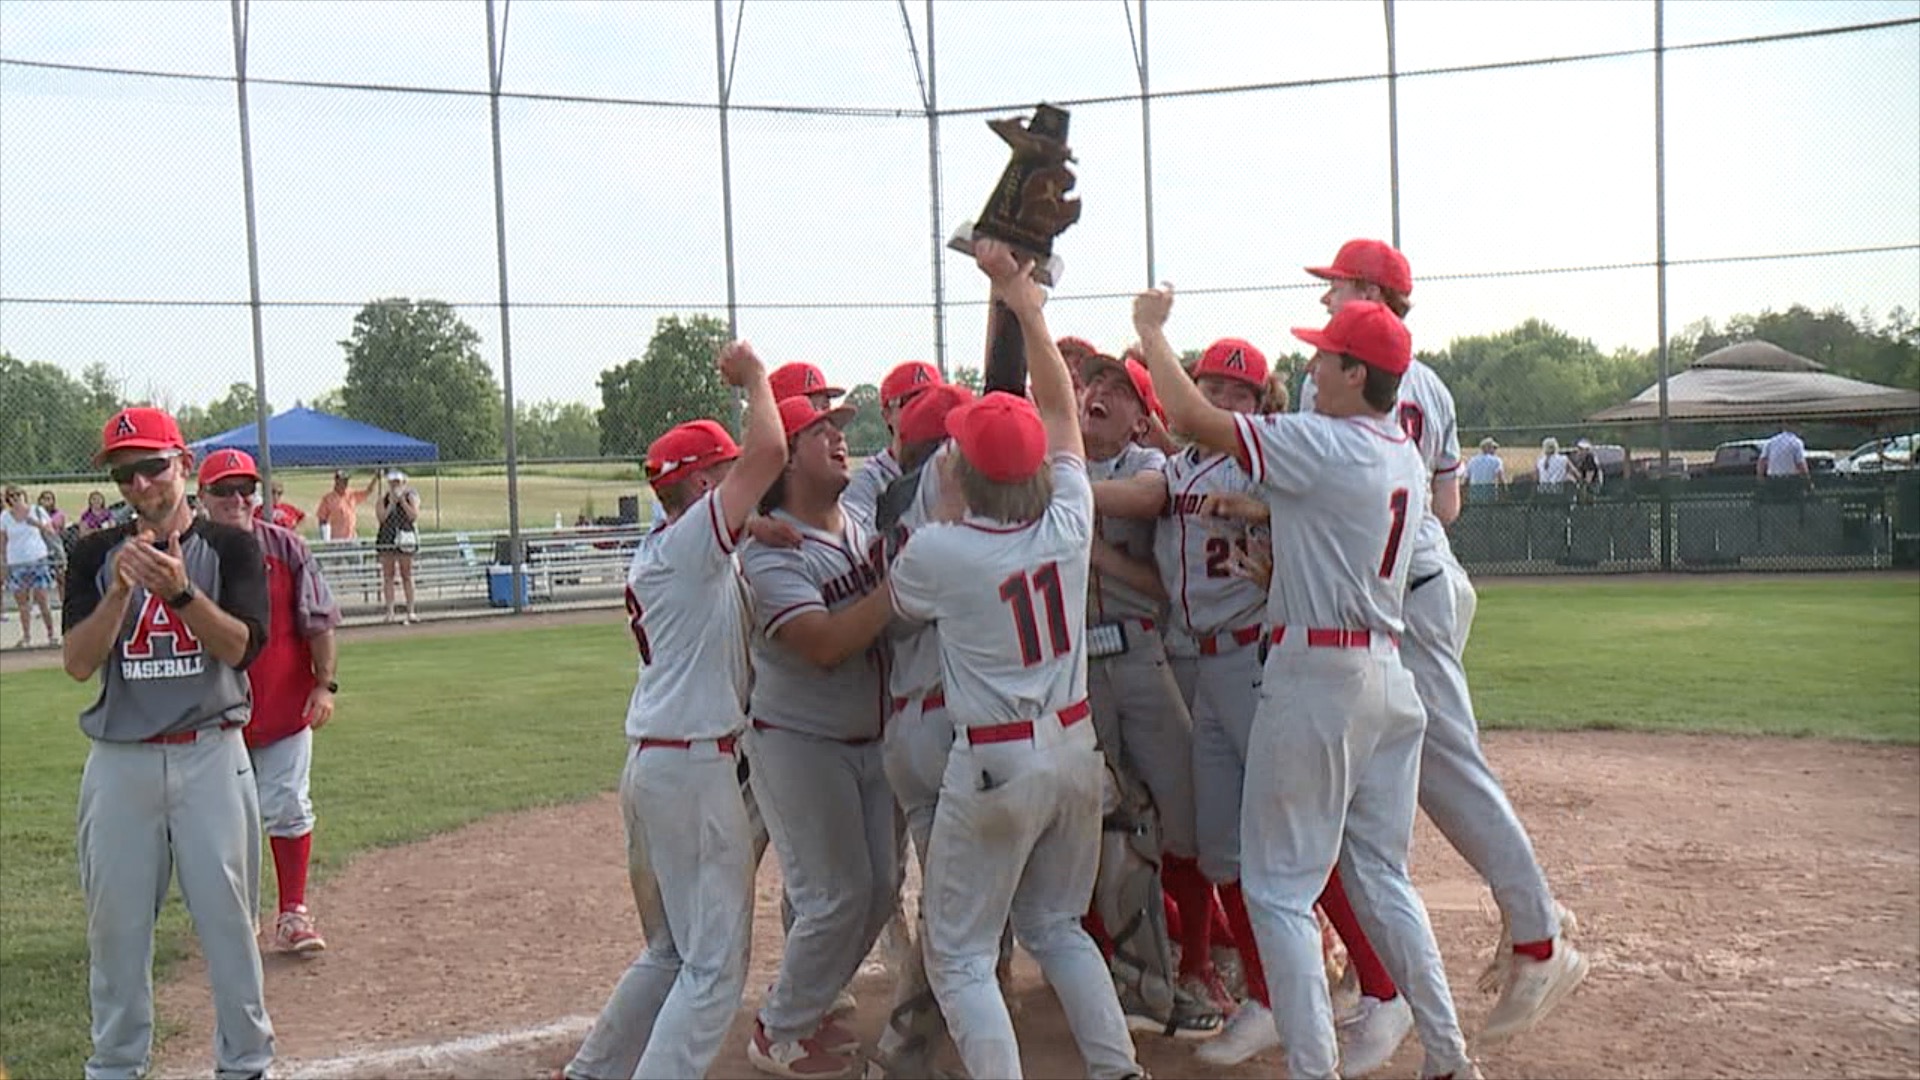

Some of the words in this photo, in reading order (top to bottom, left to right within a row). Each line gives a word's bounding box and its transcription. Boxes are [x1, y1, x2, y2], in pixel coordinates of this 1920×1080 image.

[1223, 349, 1247, 371] A
[805, 368, 821, 387] A
[914, 365, 931, 384] A
[116, 413, 138, 437] A
[227, 452, 243, 469] A
[1379, 488, 1410, 580] 1
[123, 588, 203, 660] A
[999, 561, 1071, 669] 11
[121, 656, 205, 680] BASEBALL
